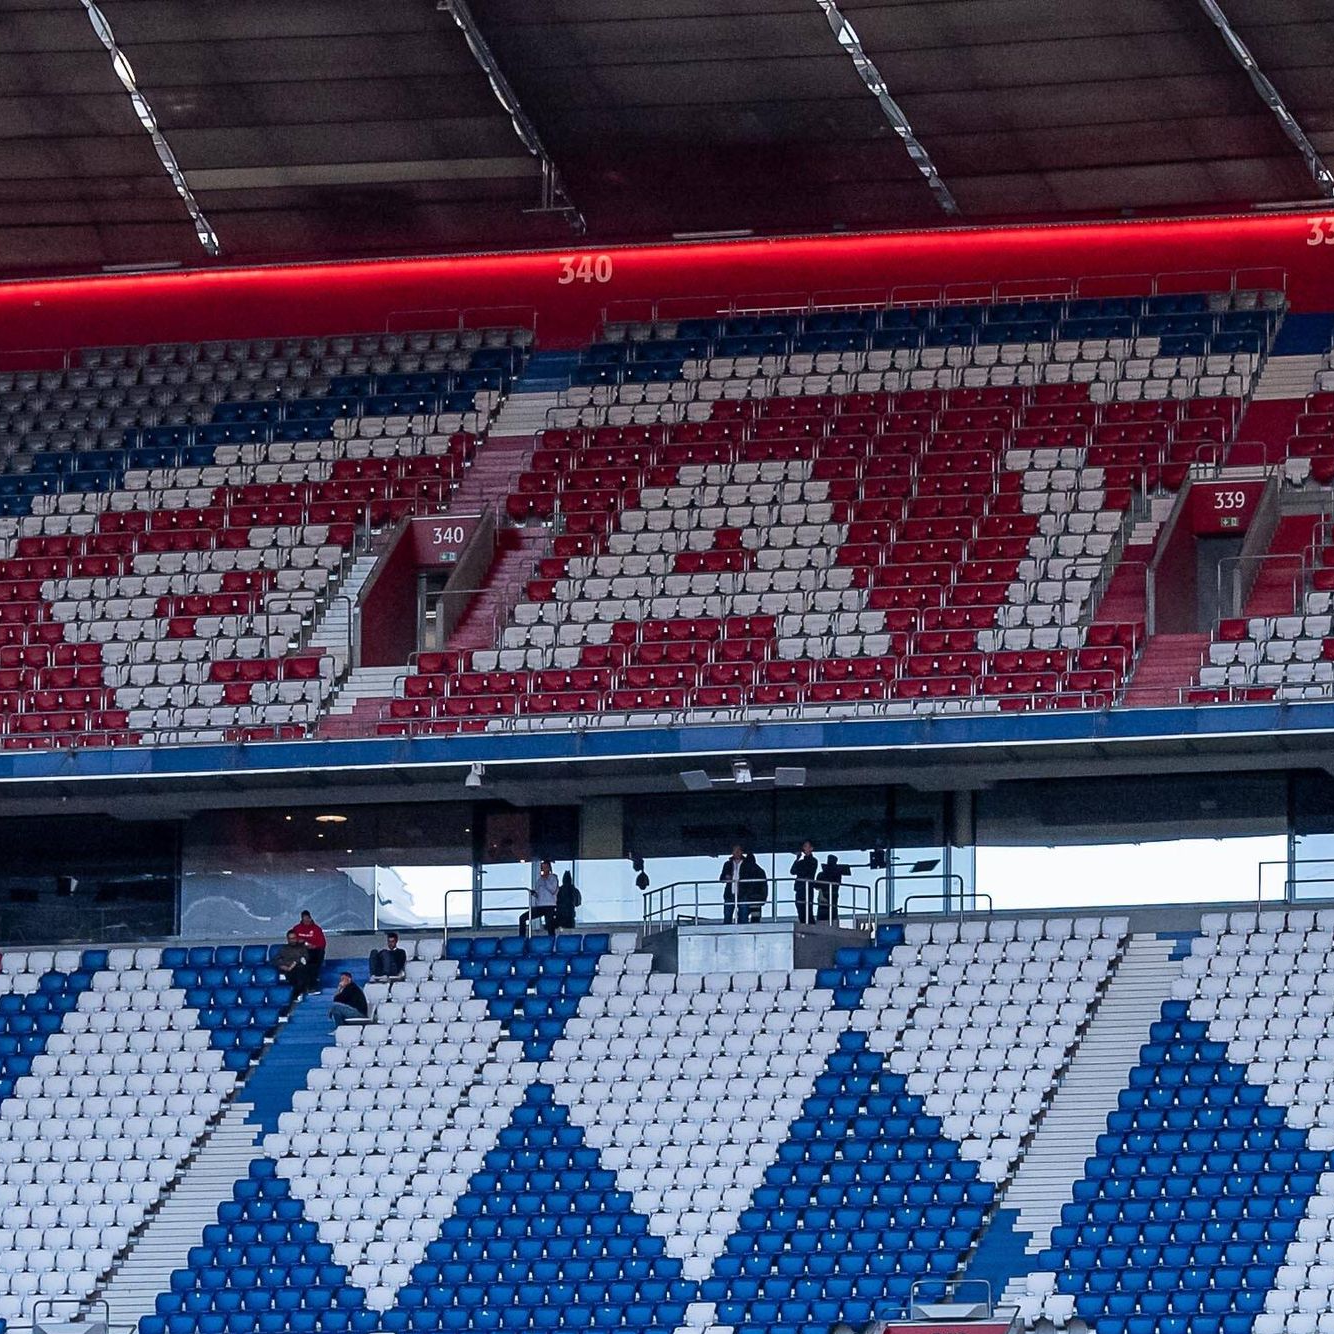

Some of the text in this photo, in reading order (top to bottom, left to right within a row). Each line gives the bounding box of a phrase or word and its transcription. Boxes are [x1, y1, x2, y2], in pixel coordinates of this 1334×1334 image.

[558, 255, 613, 284] 340
[1214, 491, 1245, 509] 339
[433, 527, 464, 544] 340
